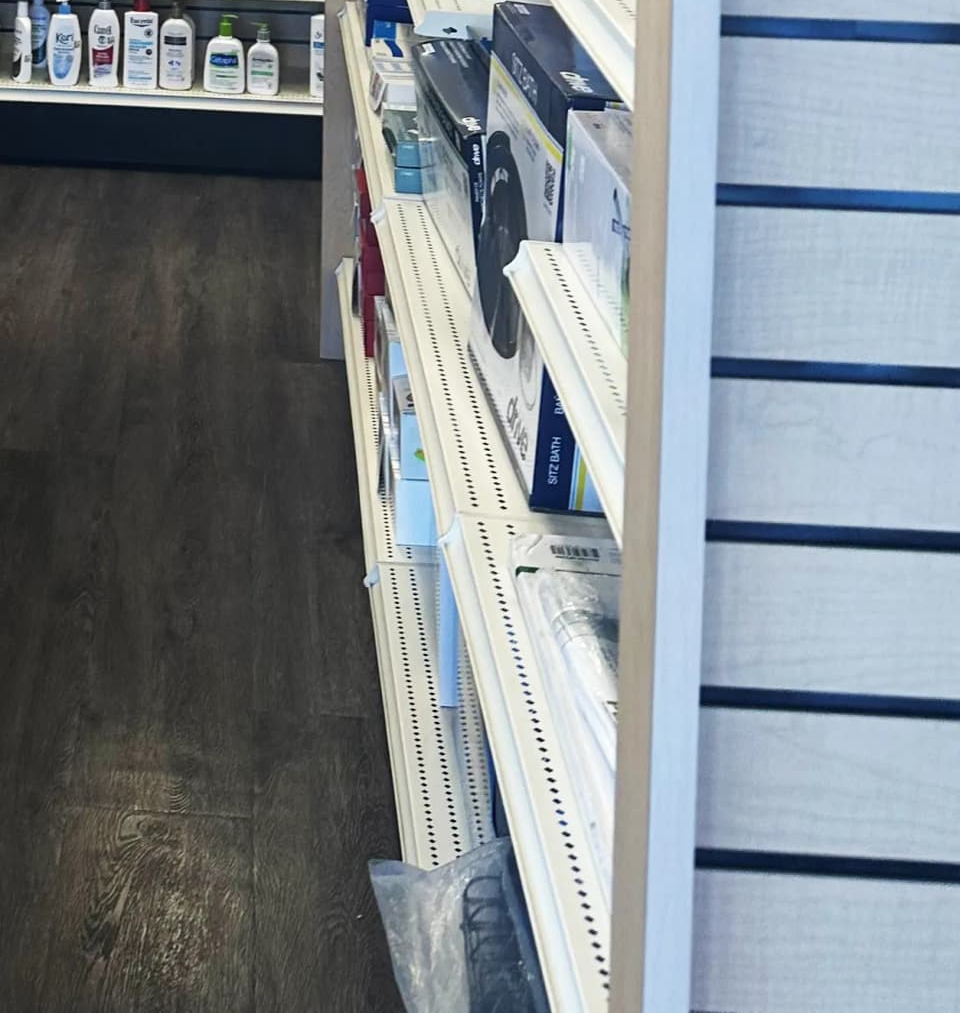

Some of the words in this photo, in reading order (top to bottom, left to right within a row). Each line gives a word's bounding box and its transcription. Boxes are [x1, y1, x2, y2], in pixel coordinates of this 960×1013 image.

[130, 16, 153, 24] Eucerin
[55, 33, 75, 45] Keri
[209, 54, 239, 66] Cetaphil
[472, 143, 481, 166] drive
[549, 436, 562, 463] BATH
[547, 463, 560, 485] SITZ
